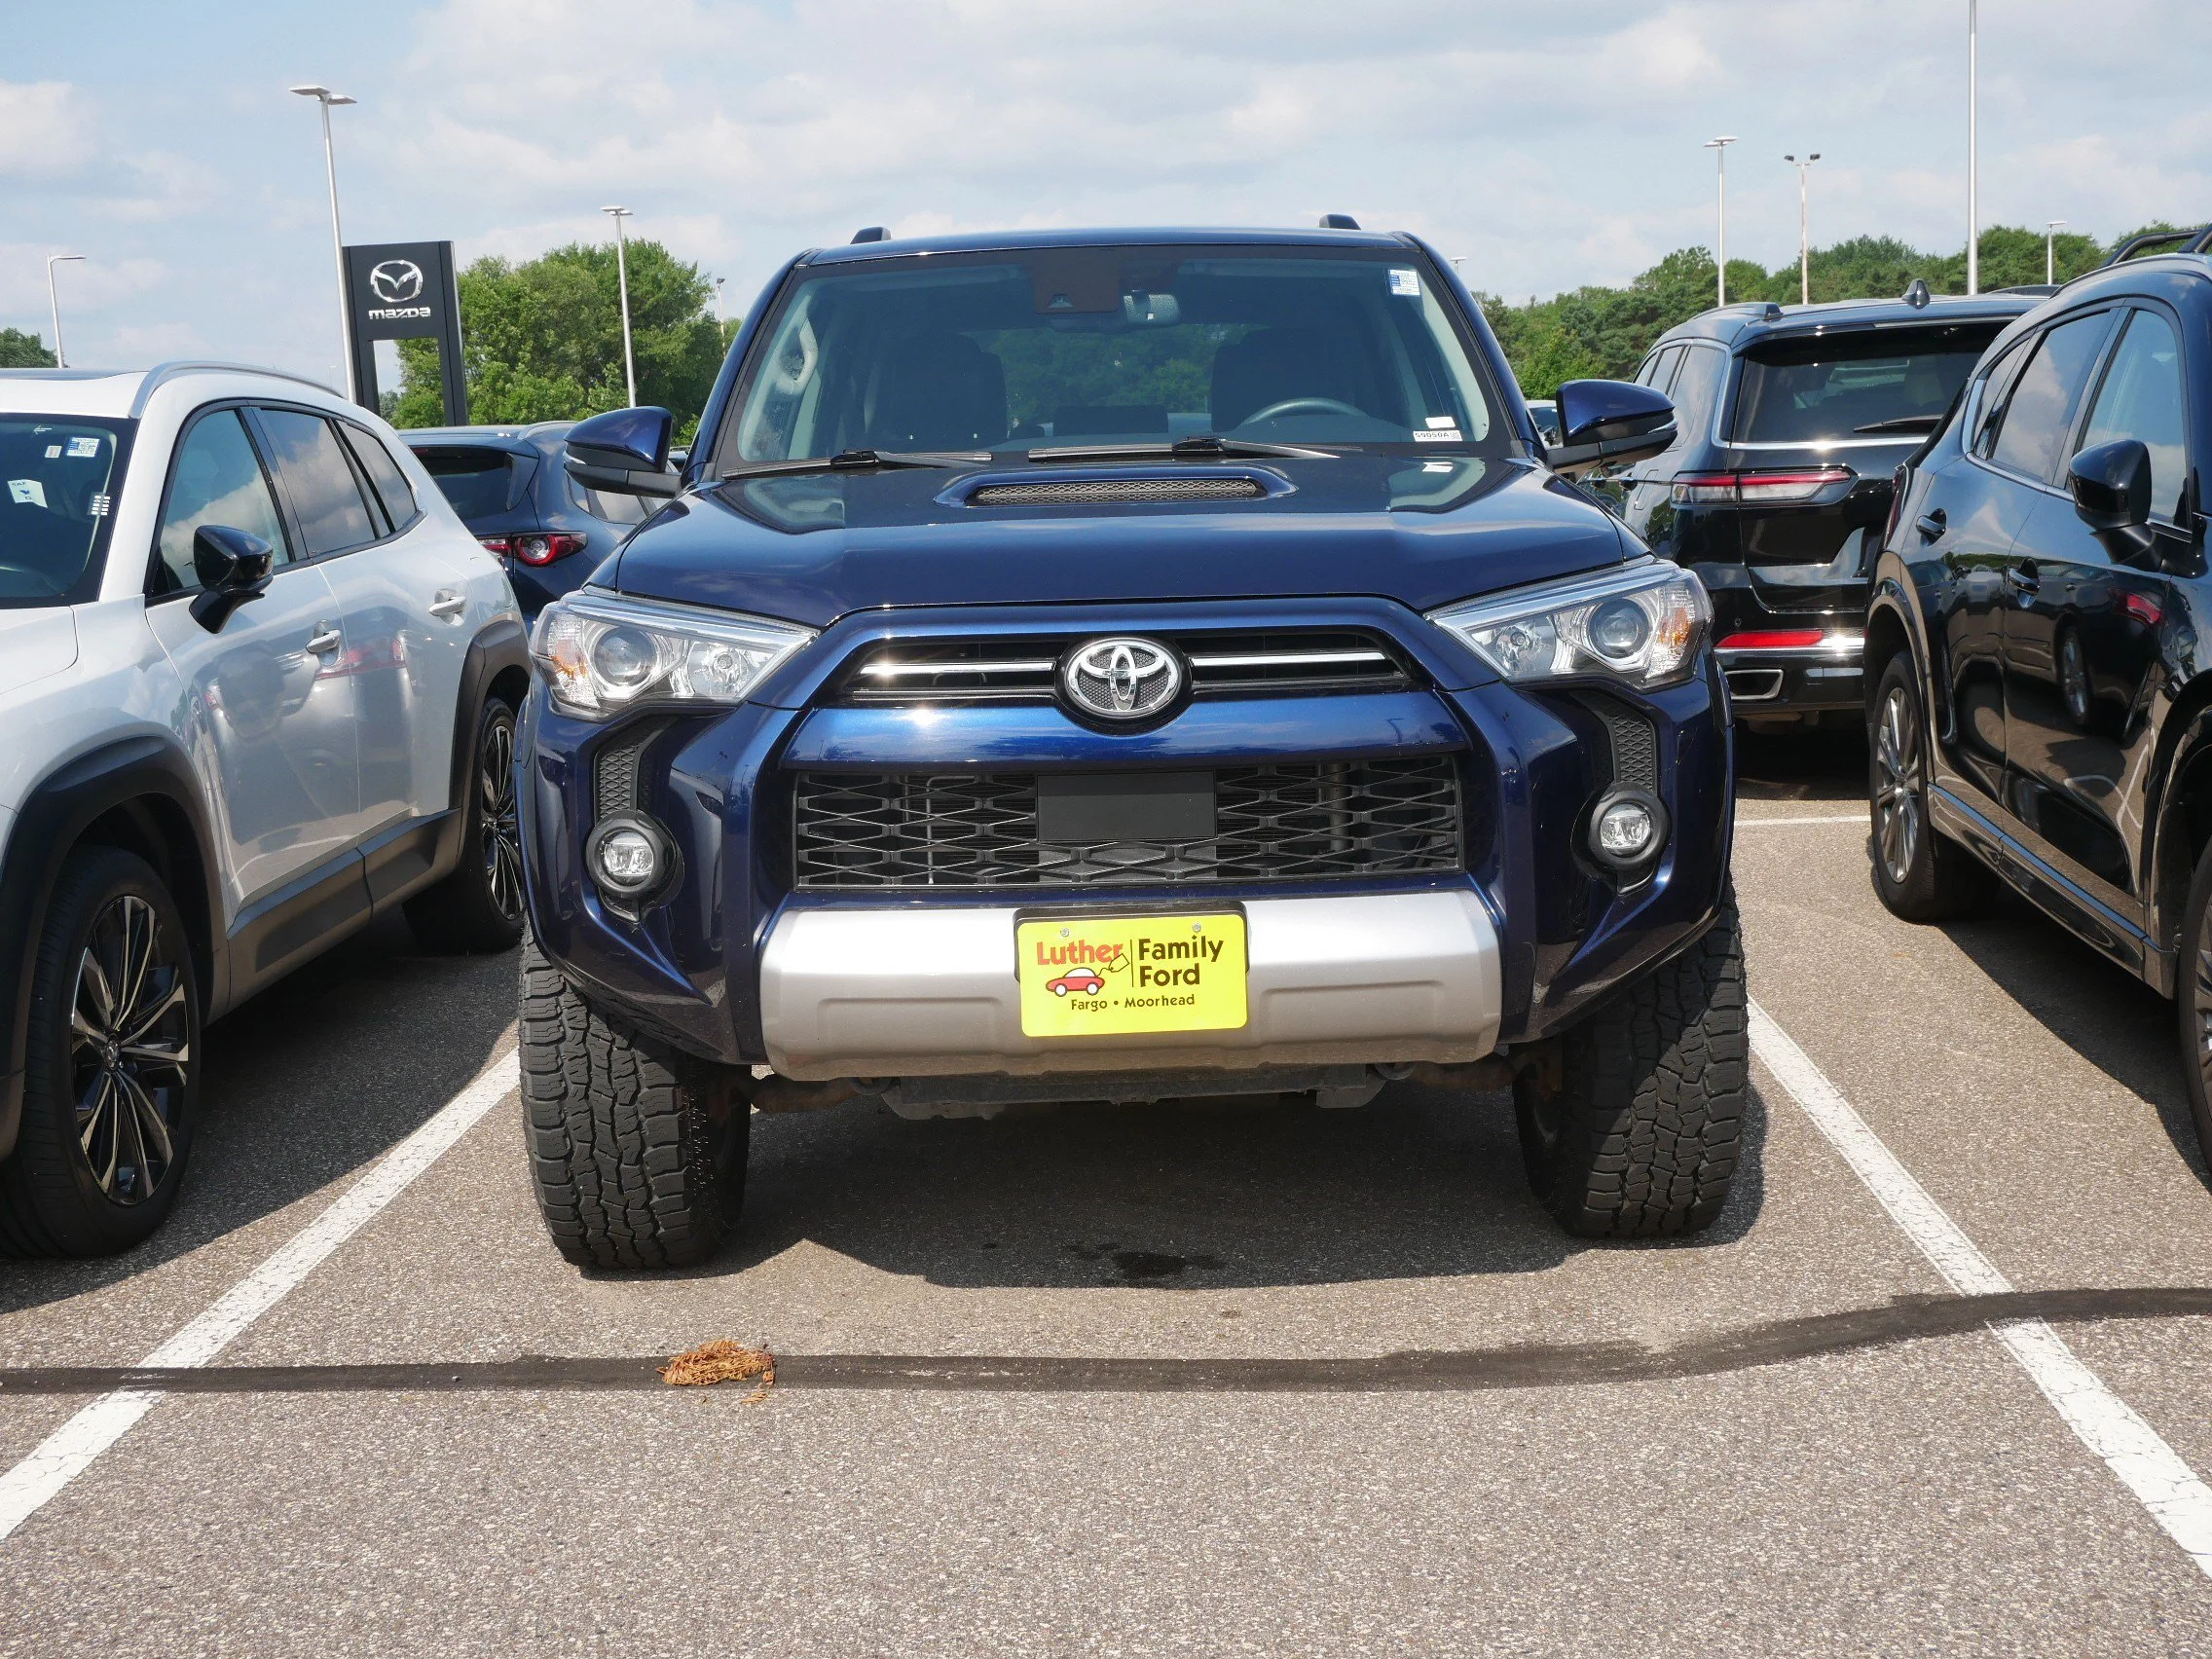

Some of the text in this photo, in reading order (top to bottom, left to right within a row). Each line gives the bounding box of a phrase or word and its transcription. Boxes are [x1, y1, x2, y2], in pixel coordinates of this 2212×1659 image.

[1036, 939, 1124, 966] Luther
[1138, 935, 1224, 962] Family
[1139, 963, 1200, 988] Ford
[1071, 994, 1196, 1013] Fargo Moorhead
